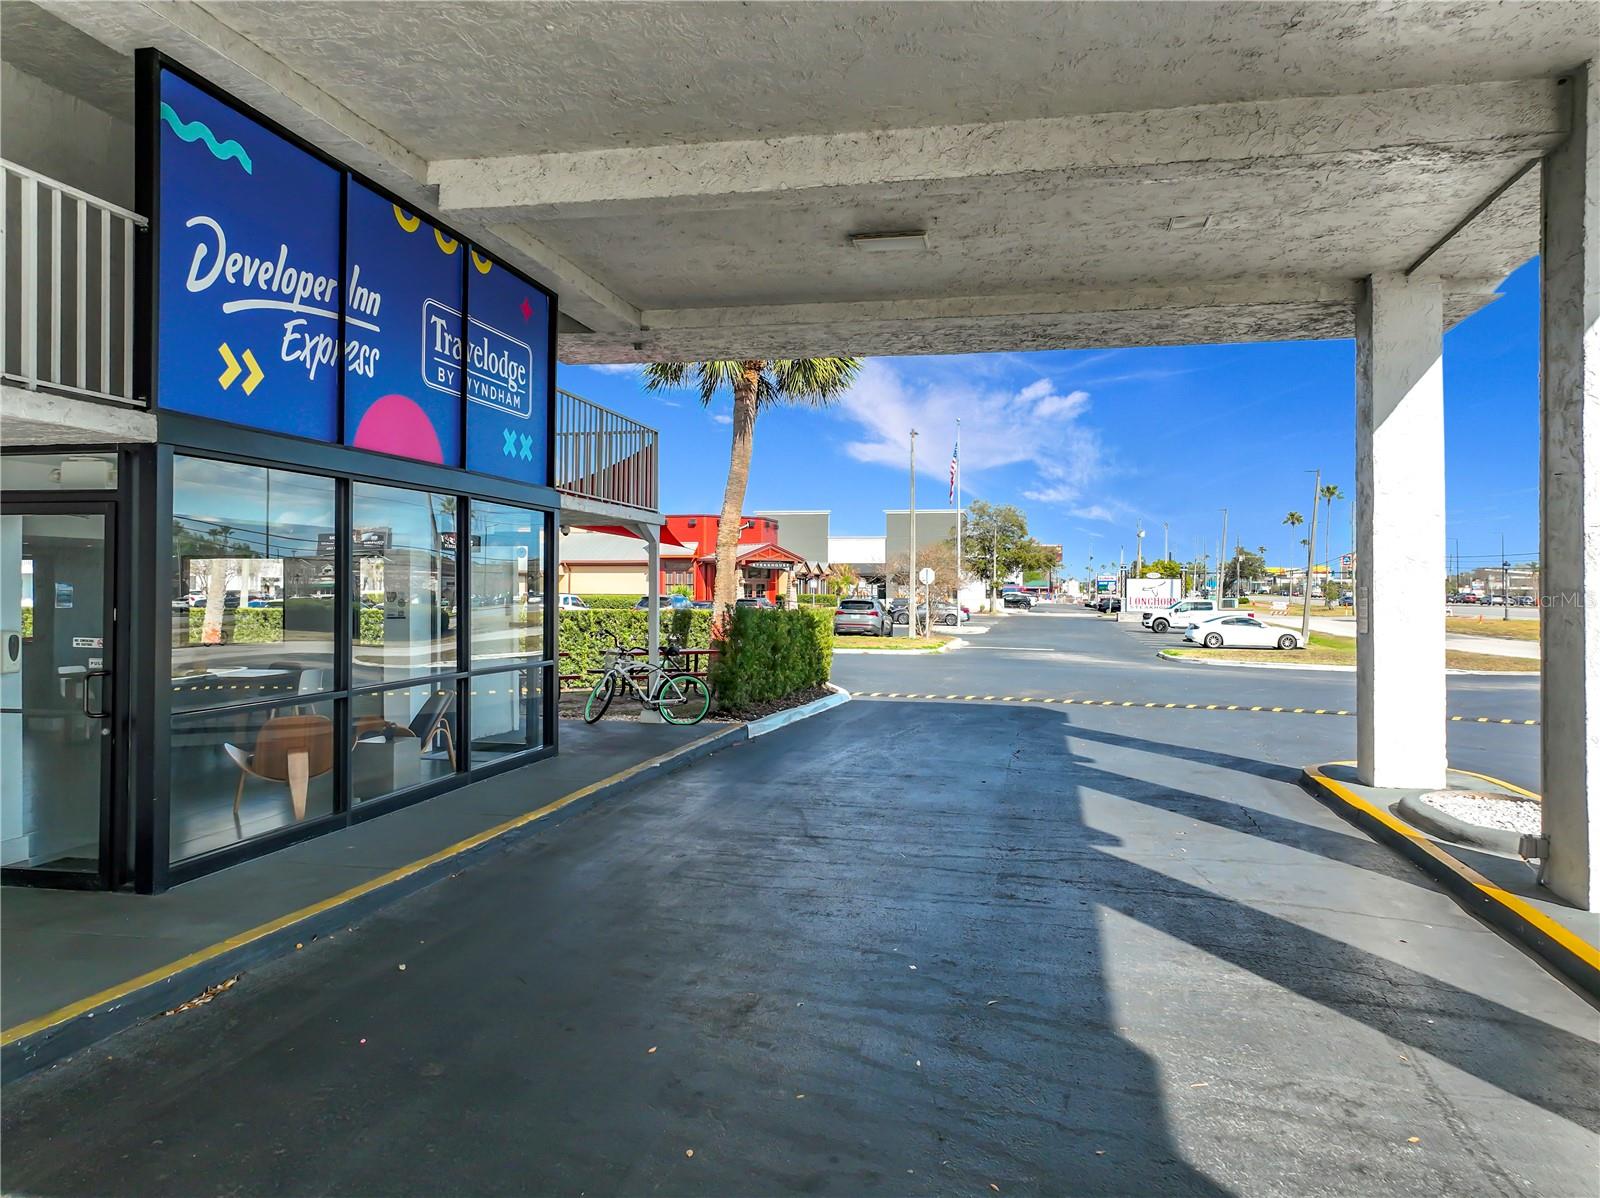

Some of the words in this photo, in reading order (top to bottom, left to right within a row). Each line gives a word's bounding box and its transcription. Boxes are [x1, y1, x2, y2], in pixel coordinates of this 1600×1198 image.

[186, 215, 337, 312] Developer
[349, 264, 381, 316] Inn
[430, 315, 525, 392] Travelodge
[438, 367, 454, 384] BY
